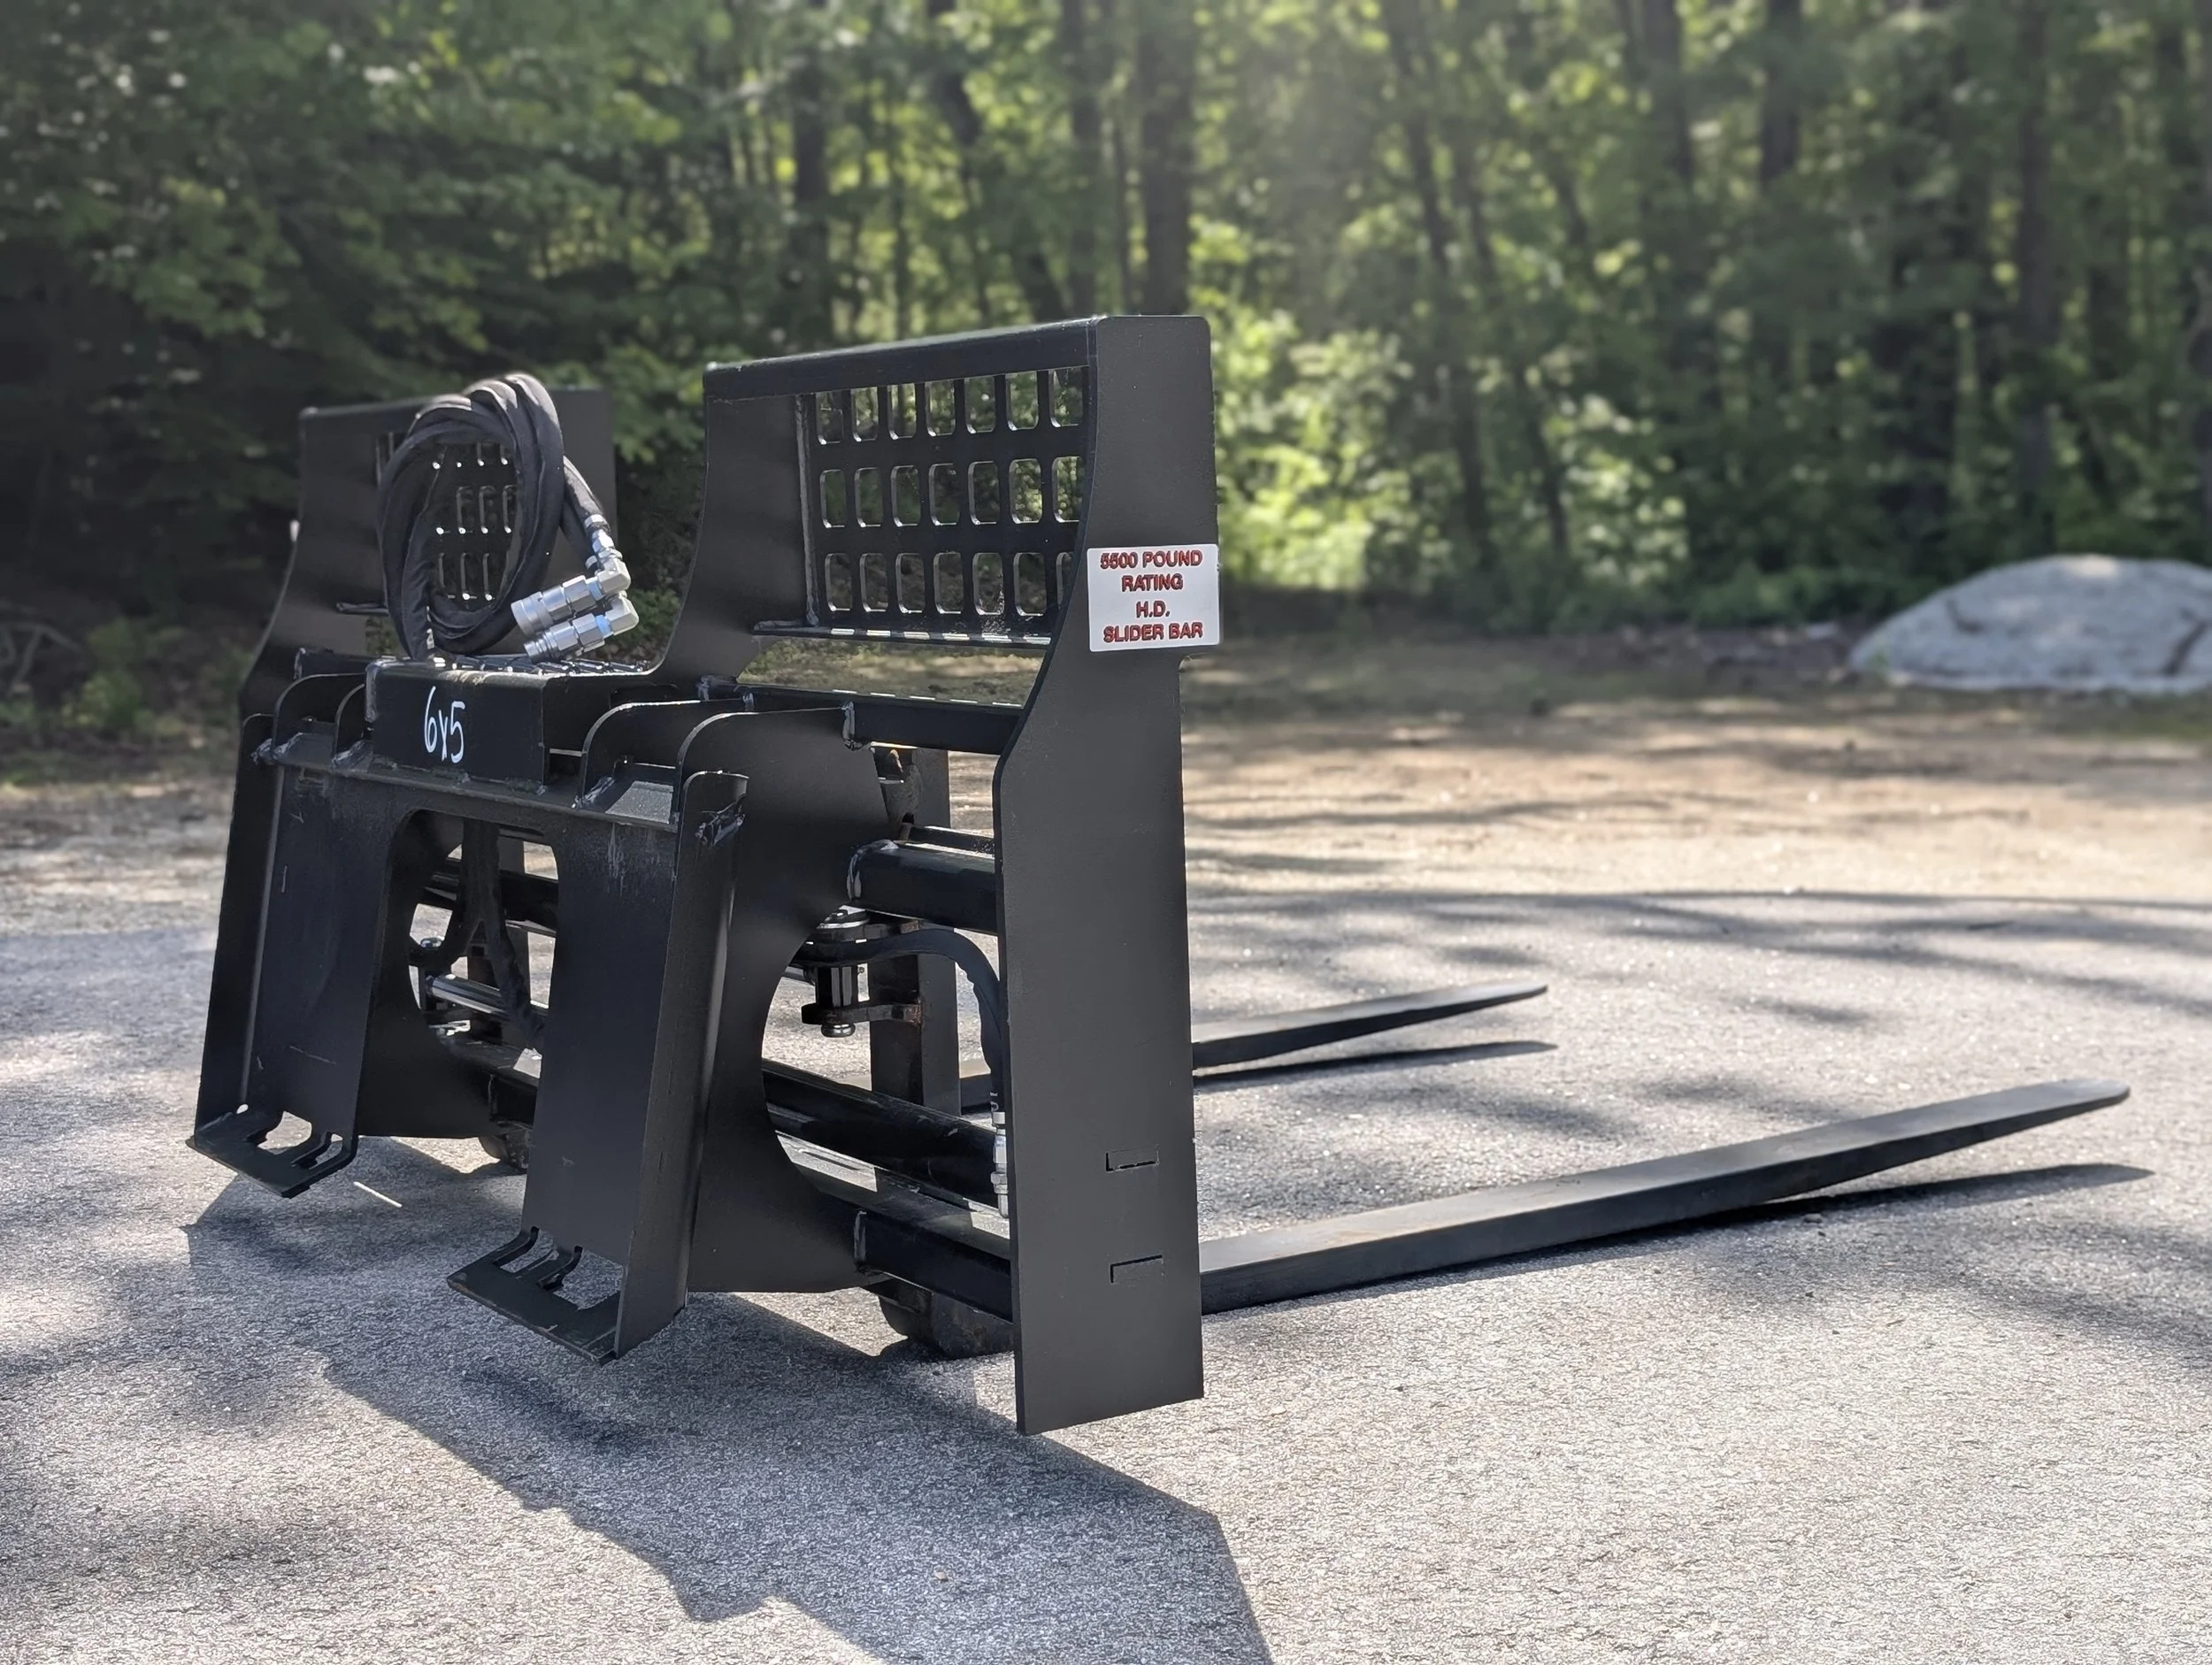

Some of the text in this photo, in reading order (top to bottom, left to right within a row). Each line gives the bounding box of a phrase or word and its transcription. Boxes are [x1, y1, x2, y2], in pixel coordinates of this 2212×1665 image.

[1101, 549, 1202, 569] 5500 POUND
[1121, 573, 1183, 592] RATING
[1136, 601, 1171, 618] H.D.
[1103, 622, 1203, 643] SLIDER BAR
